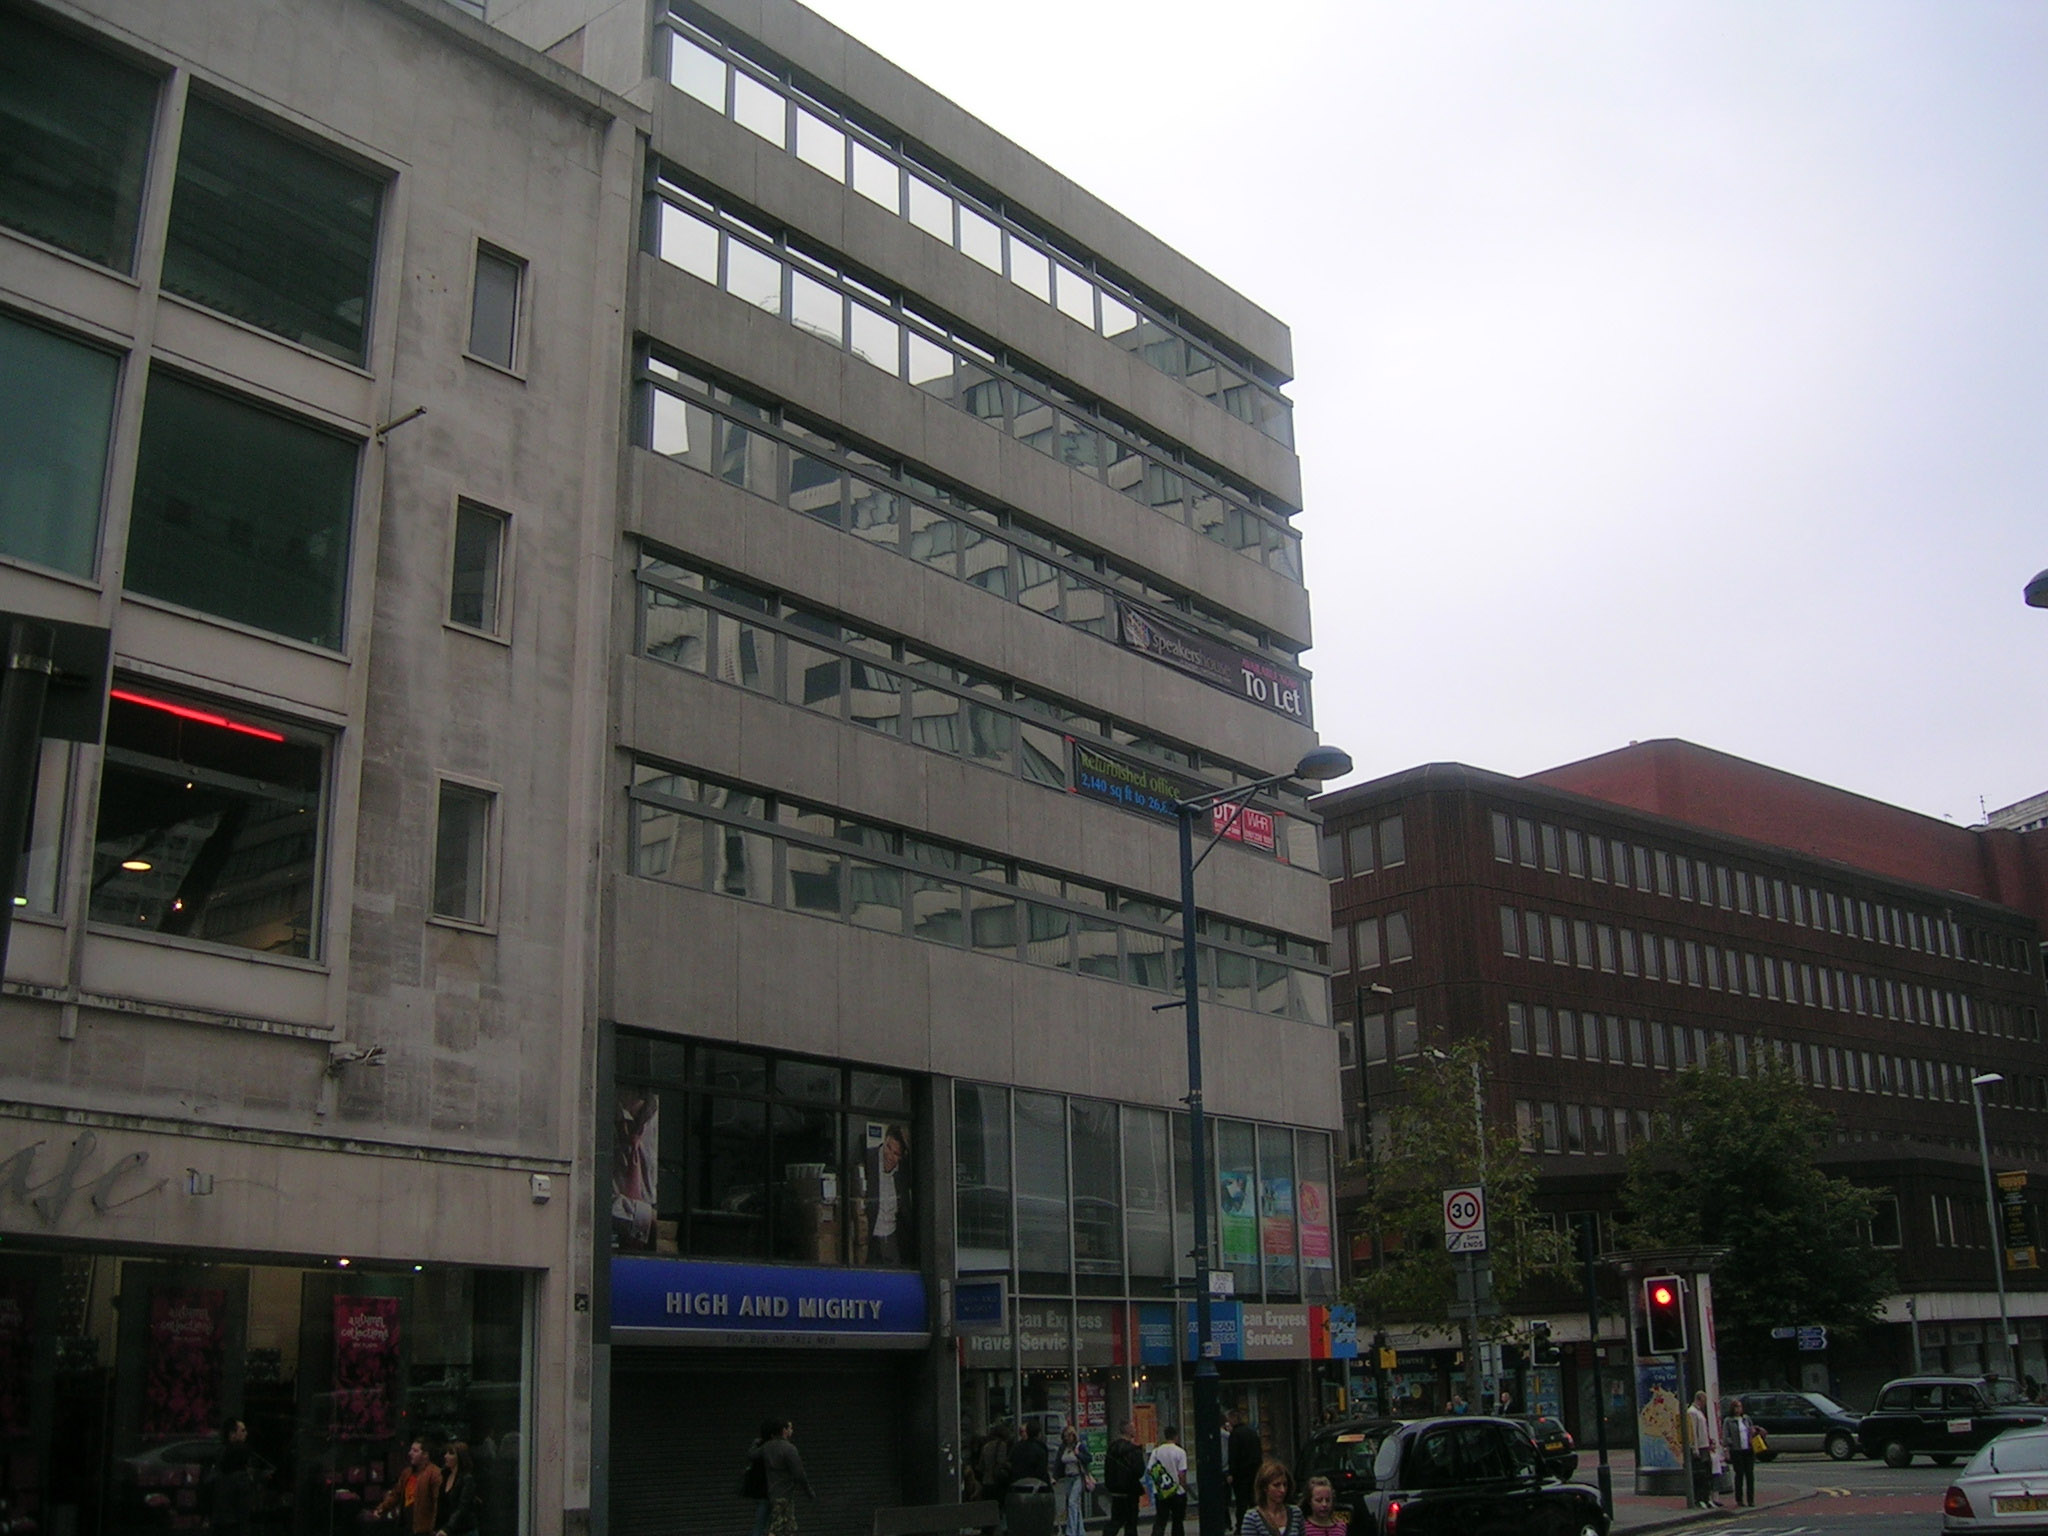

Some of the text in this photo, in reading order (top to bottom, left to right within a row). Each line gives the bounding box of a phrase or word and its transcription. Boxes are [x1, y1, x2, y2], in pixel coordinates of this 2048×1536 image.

[1241, 668, 1267, 701] To
[1272, 680, 1302, 716] Let
[1081, 752, 1180, 799] Refurbished office
[1109, 784, 1123, 802] sq
[1124, 784, 1134, 801] ft
[1135, 790, 1146, 806] to
[1452, 1202, 1475, 1218] 30
[1463, 1240, 1483, 1248] ENDS
[666, 1291, 883, 1320] HIGH AND MIGHTY
[1265, 1310, 1307, 1329] Express
[971, 1332, 1083, 1350] Trave Servics
[1246, 1330, 1293, 1346] Services
